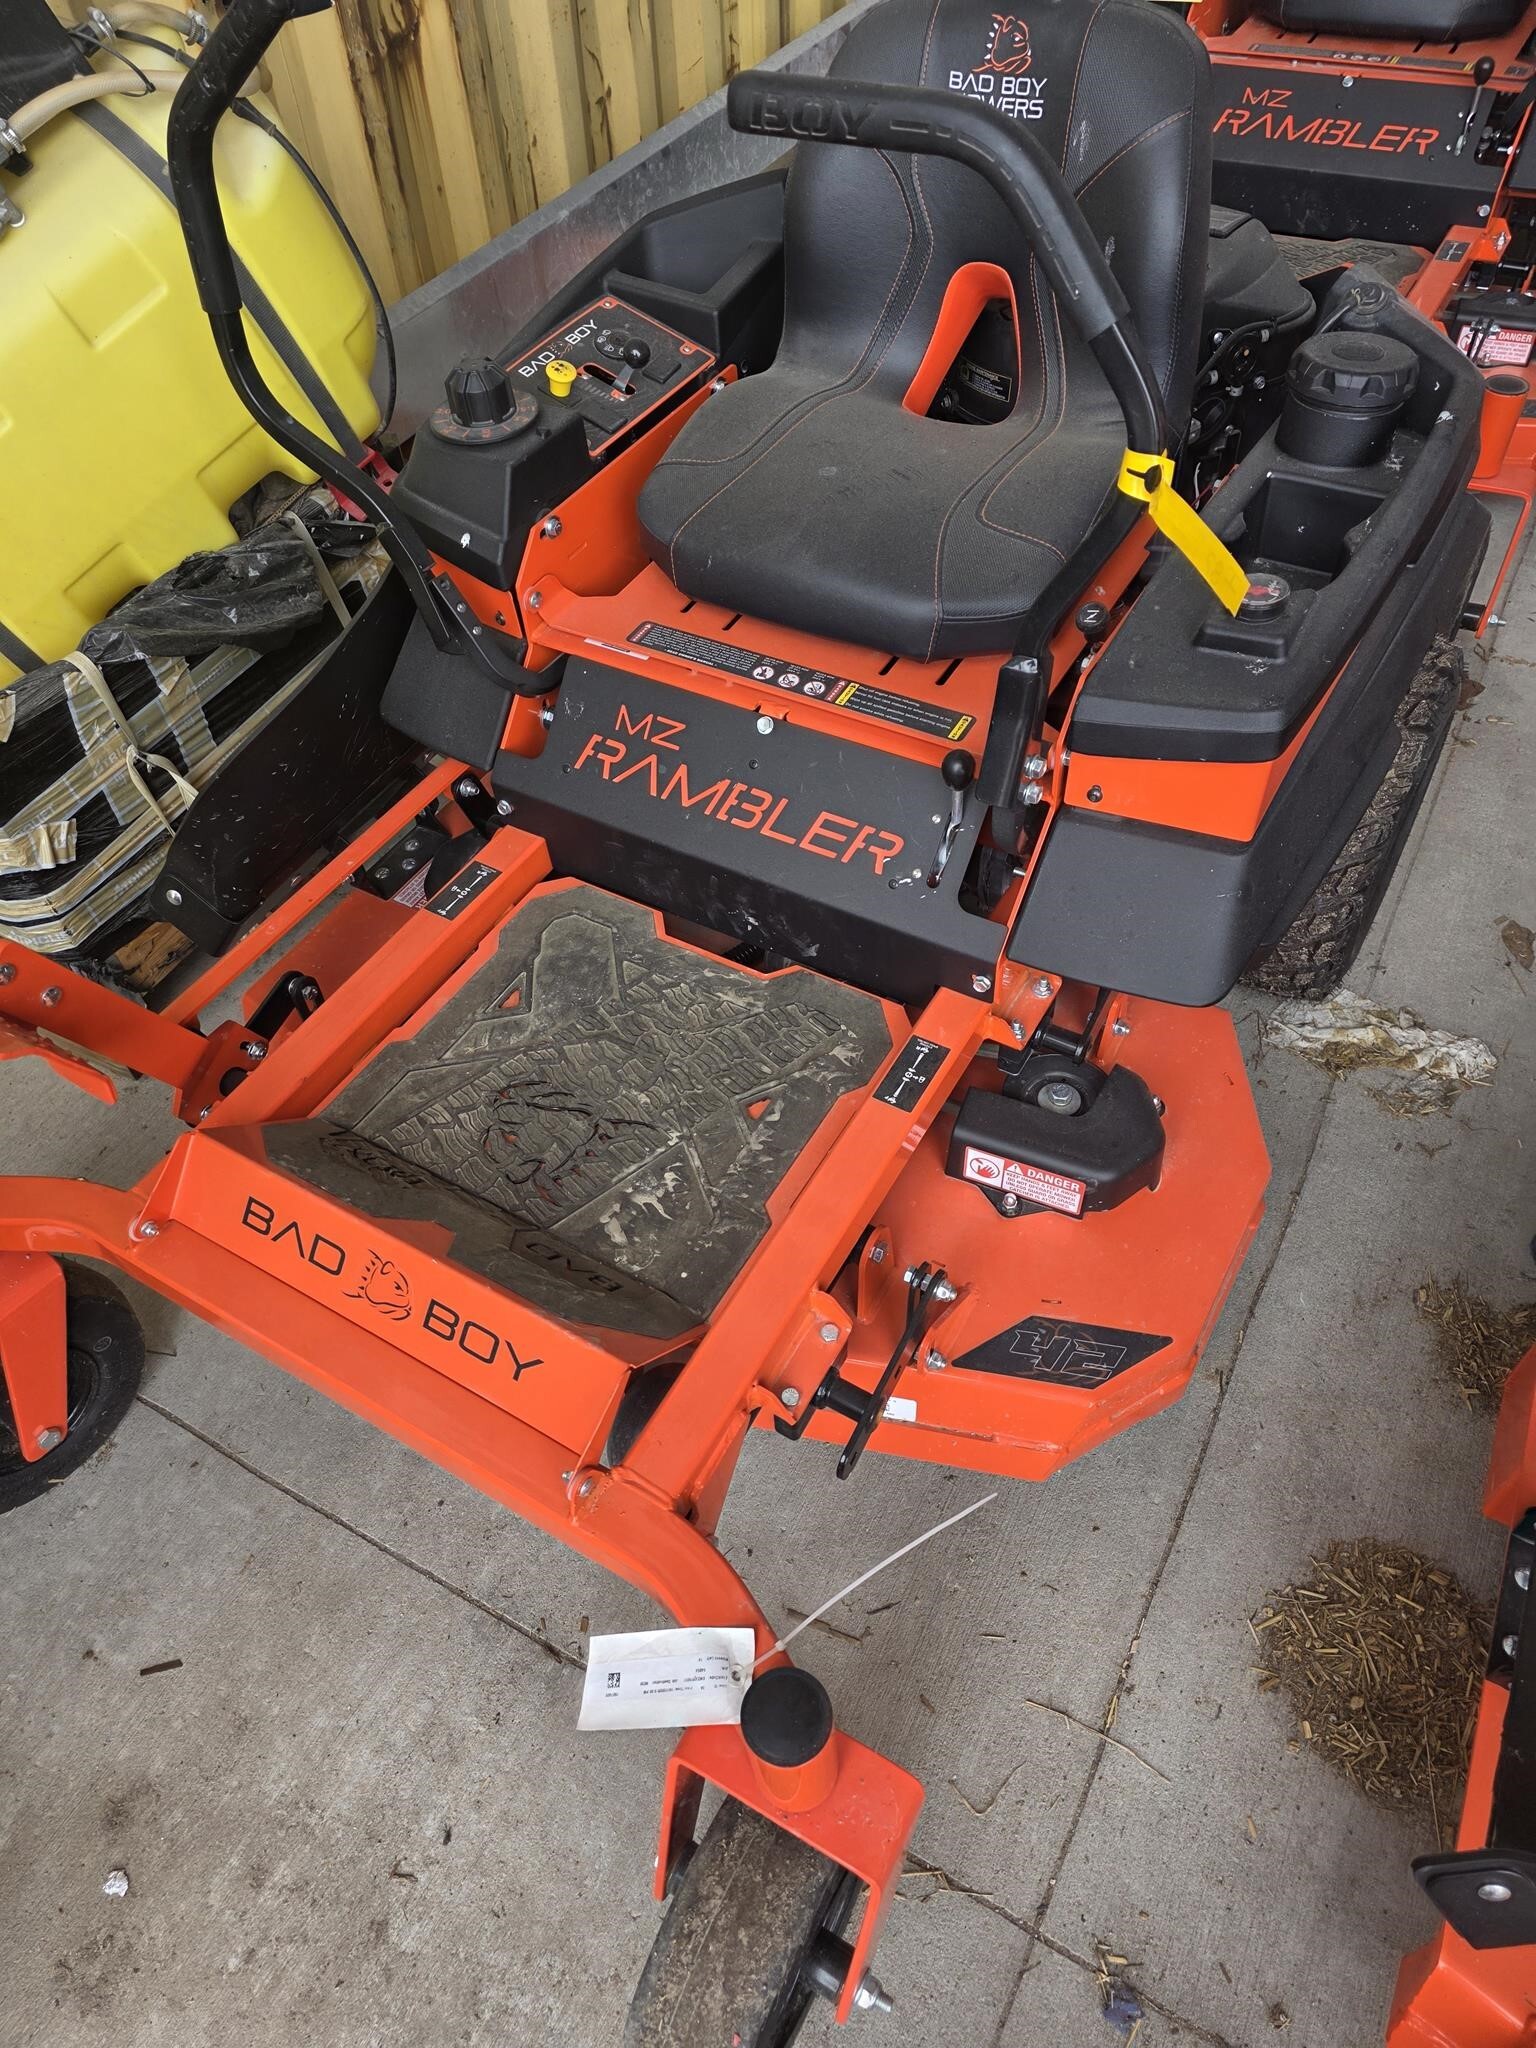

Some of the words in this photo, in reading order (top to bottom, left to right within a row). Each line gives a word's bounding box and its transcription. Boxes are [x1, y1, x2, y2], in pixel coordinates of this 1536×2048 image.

[949, 70, 994, 92] BAD
[1001, 76, 1048, 98] BOY
[1241, 87, 1293, 109] MZ
[750, 92, 881, 140] BOY
[962, 92, 1044, 119] WERS
[1212, 108, 1440, 155] RAMBLER
[518, 351, 556, 378] BAD
[564, 319, 598, 345] BOY
[1498, 331, 1533, 343] DANGER
[615, 704, 686, 751] MZ
[573, 733, 905, 875] RAMBLER
[1009, 1186, 1035, 1198] CATCHER
[1016, 1179, 1028, 1187] NOT
[1028, 1182, 1054, 1195] OPERATE
[1027, 1168, 1080, 1192] DANGER
[1028, 1187, 1047, 1197] GUARD
[1057, 1197, 1076, 1207] GRASS
[241, 1196, 346, 1276] BAD
[422, 1298, 545, 1381] BOY
[1009, 1330, 1128, 1380] 42
